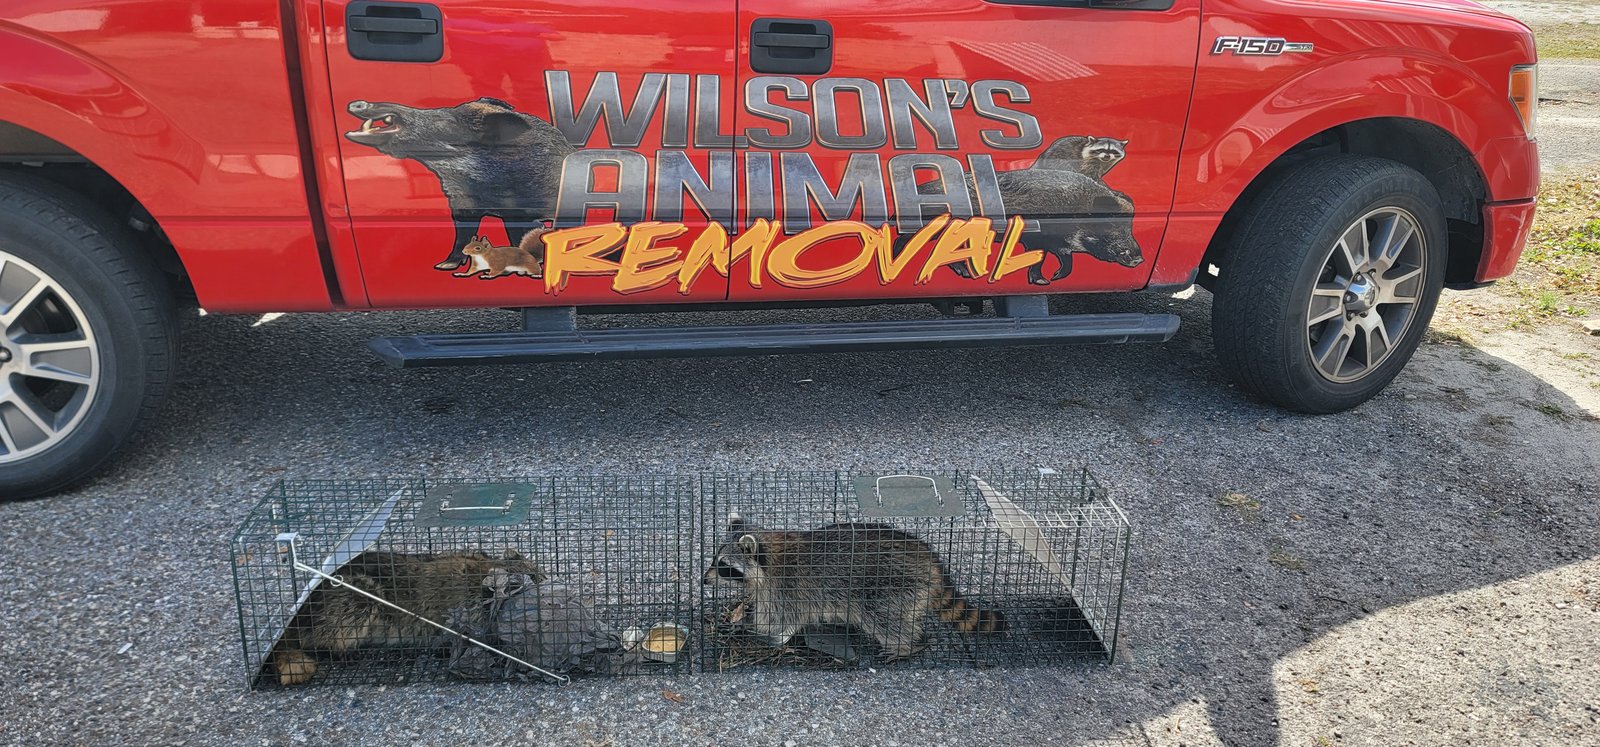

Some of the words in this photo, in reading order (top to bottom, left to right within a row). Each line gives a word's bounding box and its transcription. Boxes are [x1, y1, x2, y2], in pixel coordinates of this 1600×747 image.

[1211, 36, 1286, 55] F-150
[544, 70, 1043, 149] WILSON'S
[552, 148, 1041, 235] ANIMAL
[540, 213, 1044, 295] REMOVAL
